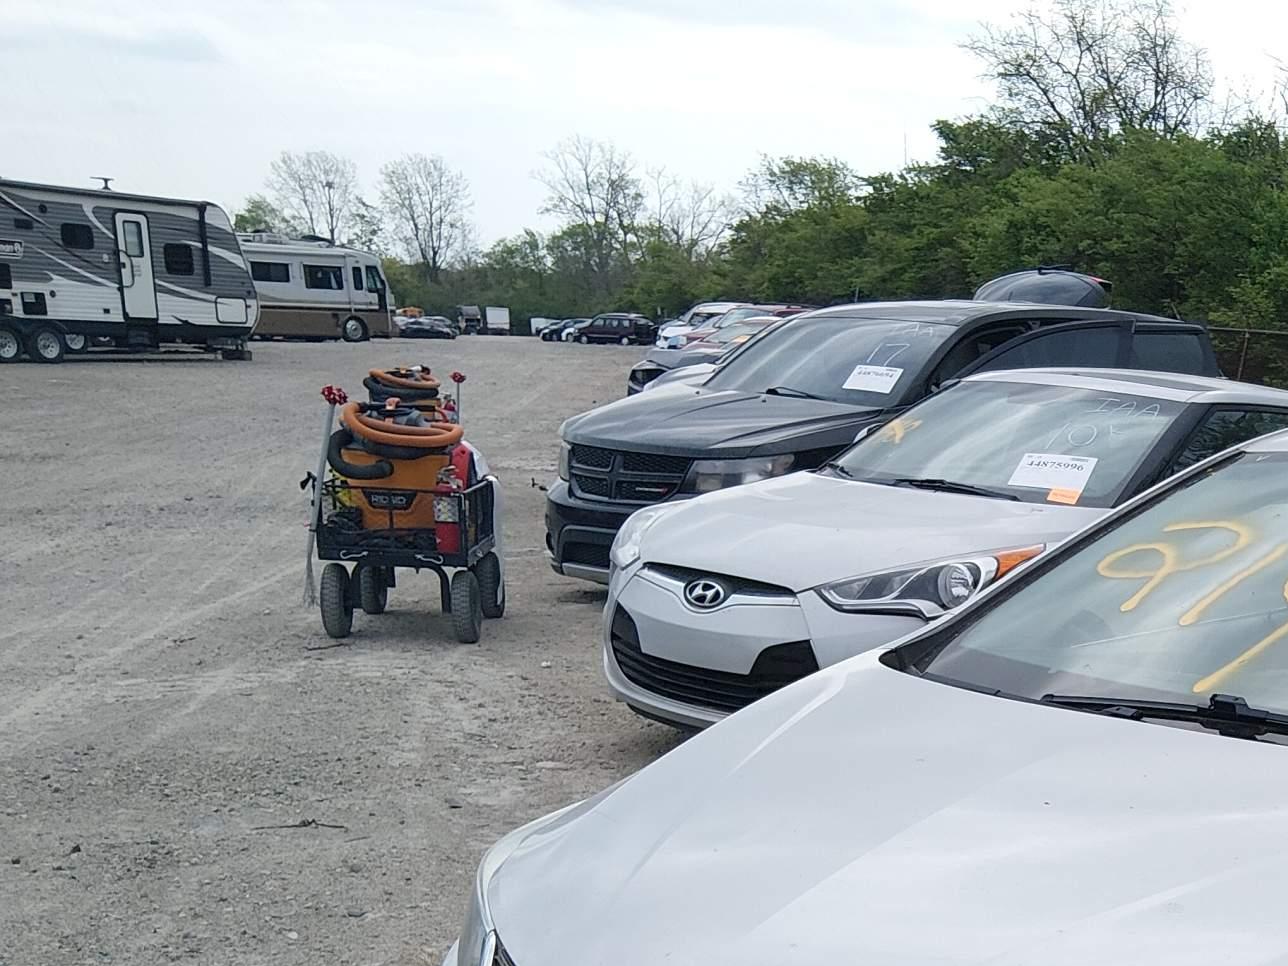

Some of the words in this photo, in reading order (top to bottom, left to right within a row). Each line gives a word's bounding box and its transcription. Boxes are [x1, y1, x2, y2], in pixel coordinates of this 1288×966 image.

[866, 342, 910, 367] 17
[1087, 397, 1162, 417] IAA
[1045, 422, 1097, 449] 10
